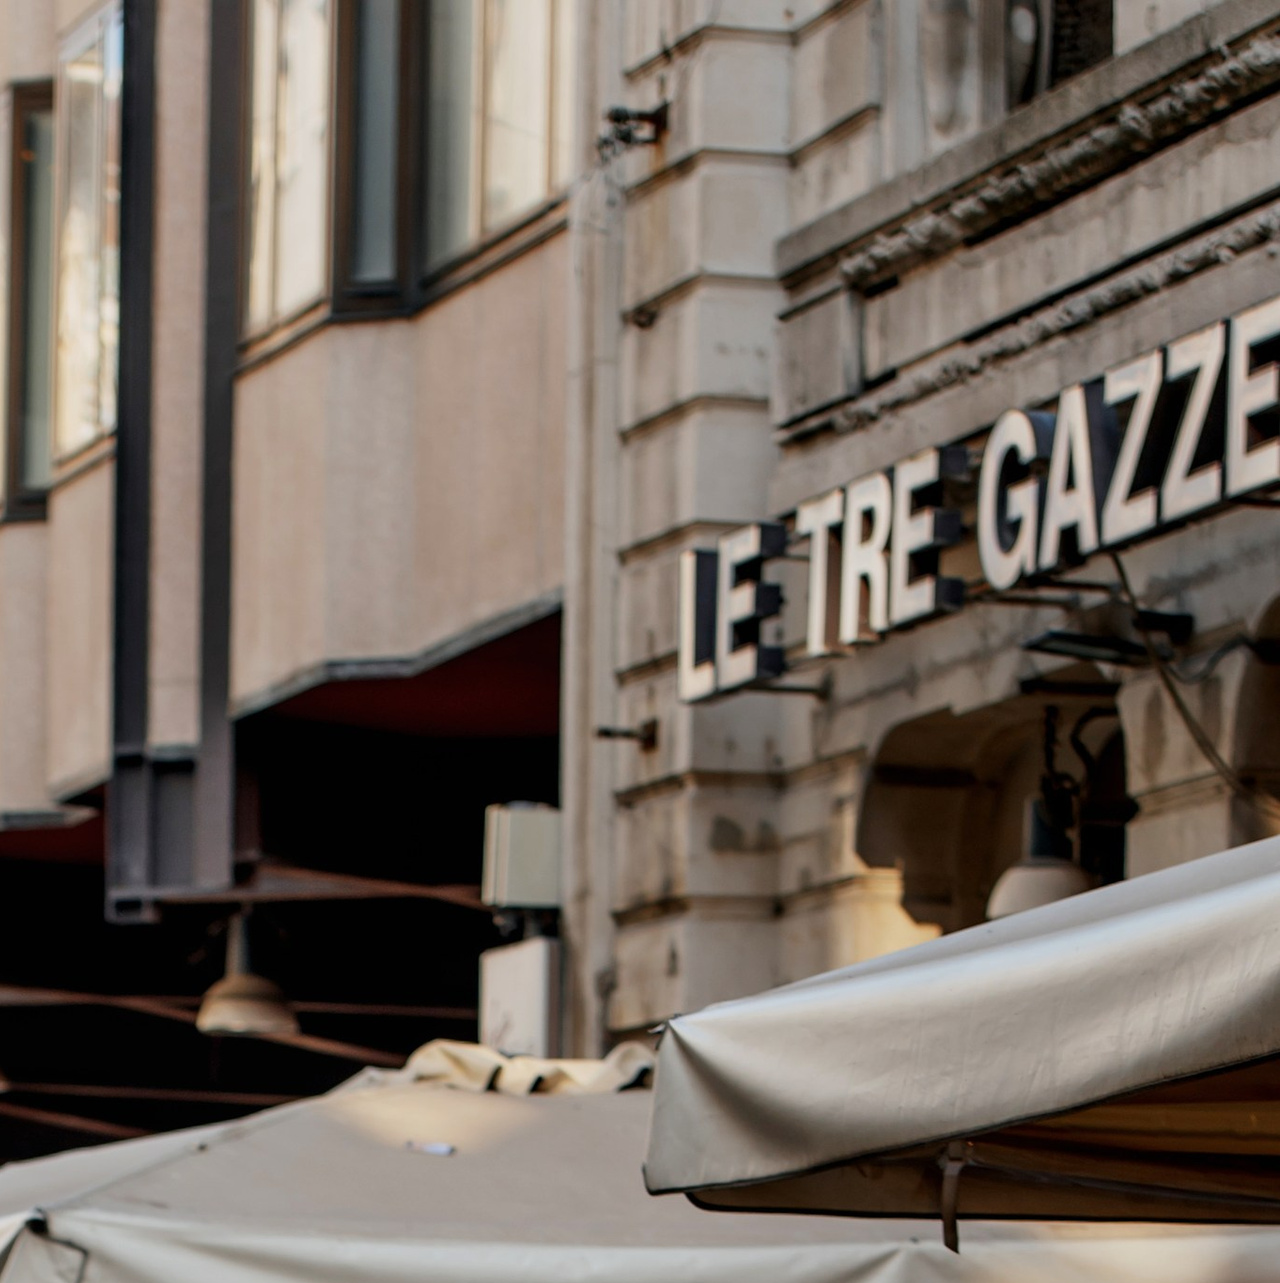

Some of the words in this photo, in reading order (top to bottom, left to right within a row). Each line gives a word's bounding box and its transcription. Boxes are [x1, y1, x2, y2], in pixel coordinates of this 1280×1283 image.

[678, 522, 763, 702] LE
[796, 447, 939, 657] TRE
[977, 295, 1280, 590] GAZZE
